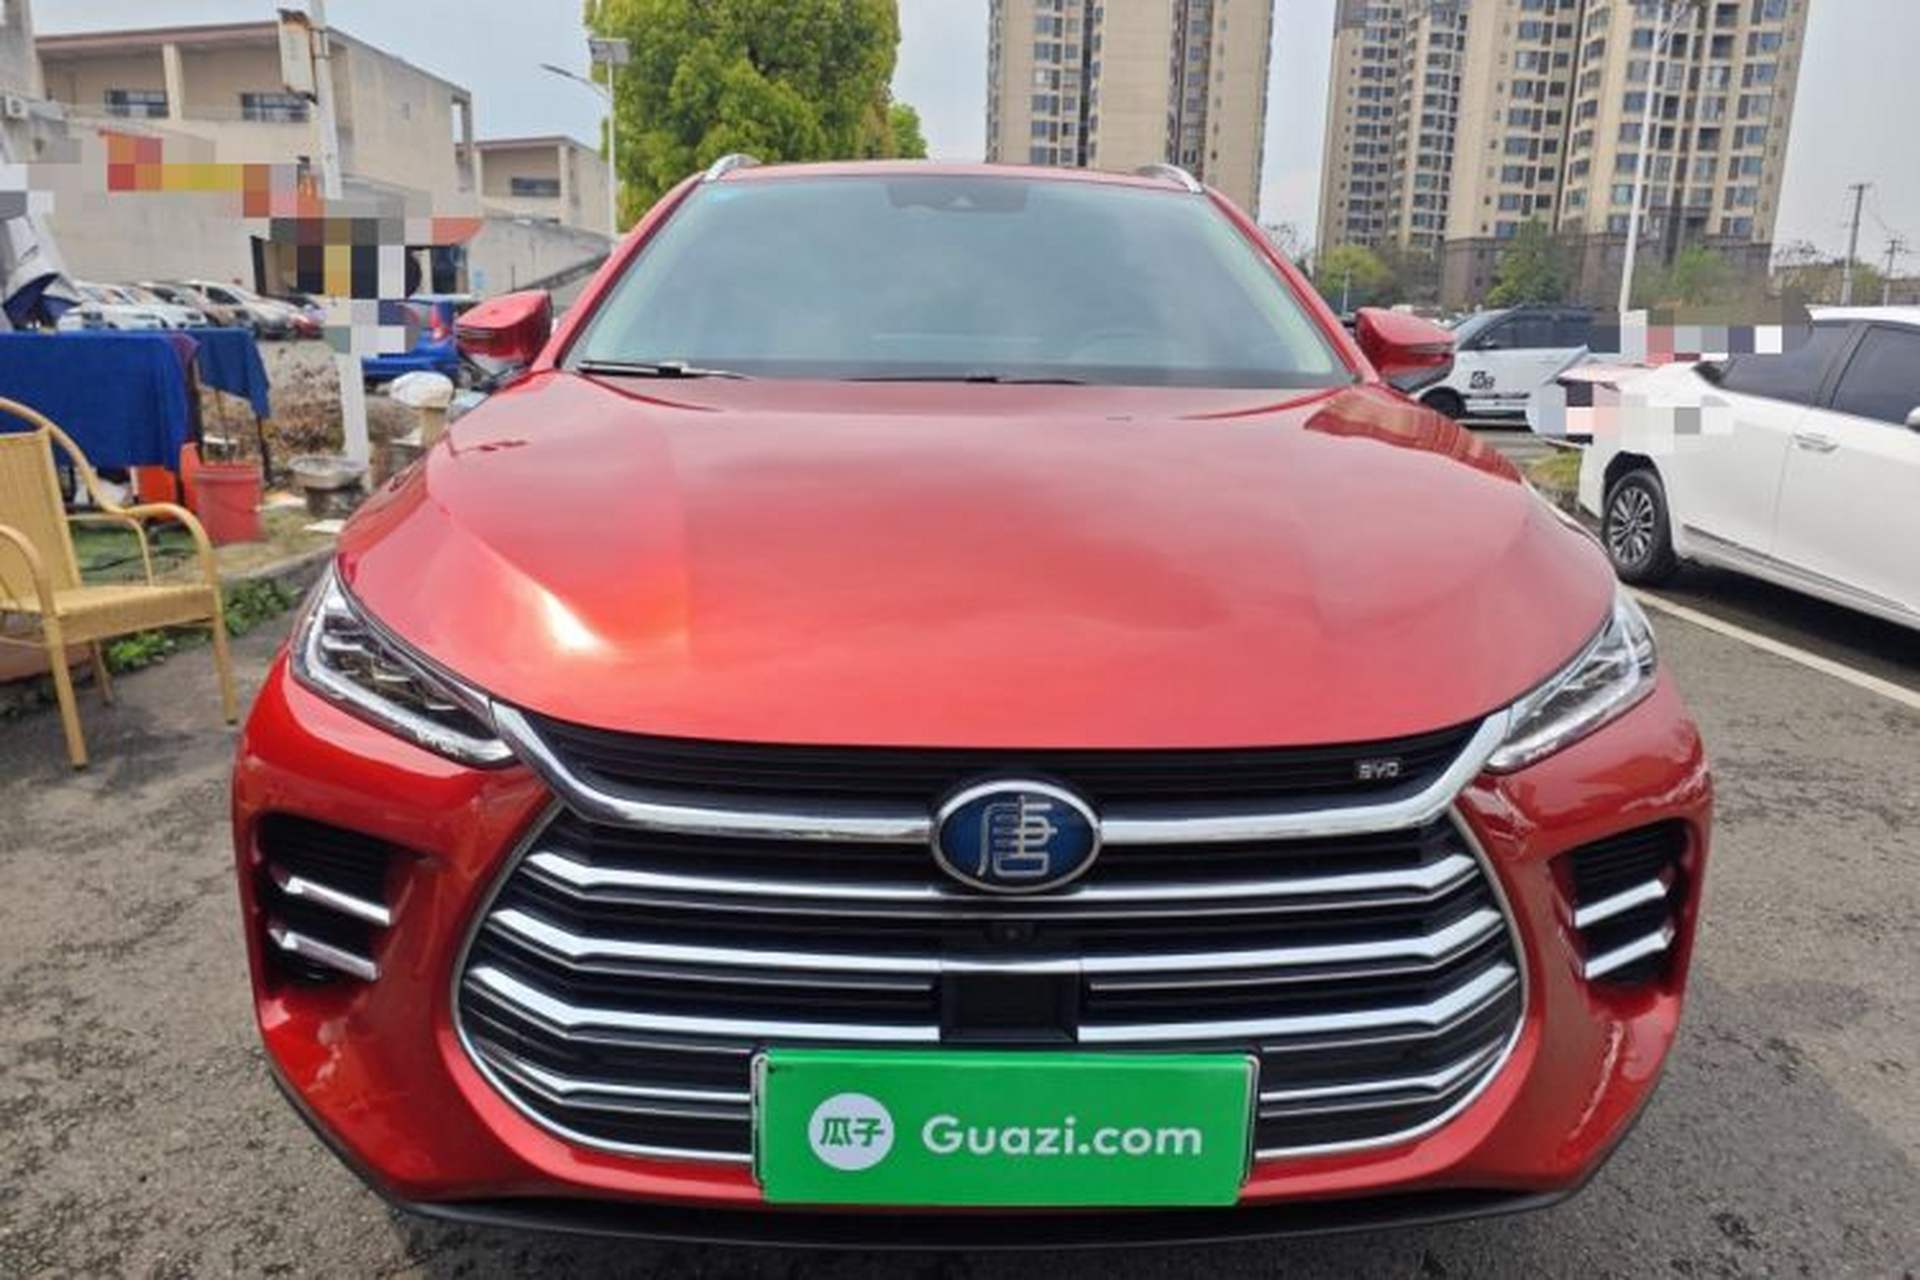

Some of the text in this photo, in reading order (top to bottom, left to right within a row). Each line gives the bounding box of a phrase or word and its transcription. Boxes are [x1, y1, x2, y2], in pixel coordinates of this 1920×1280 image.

[1359, 762, 1399, 779] BYD
[976, 794, 1058, 877] 唐
[820, 1116, 885, 1148] 瓜子
[921, 1113, 1202, 1156] Guazi.com
